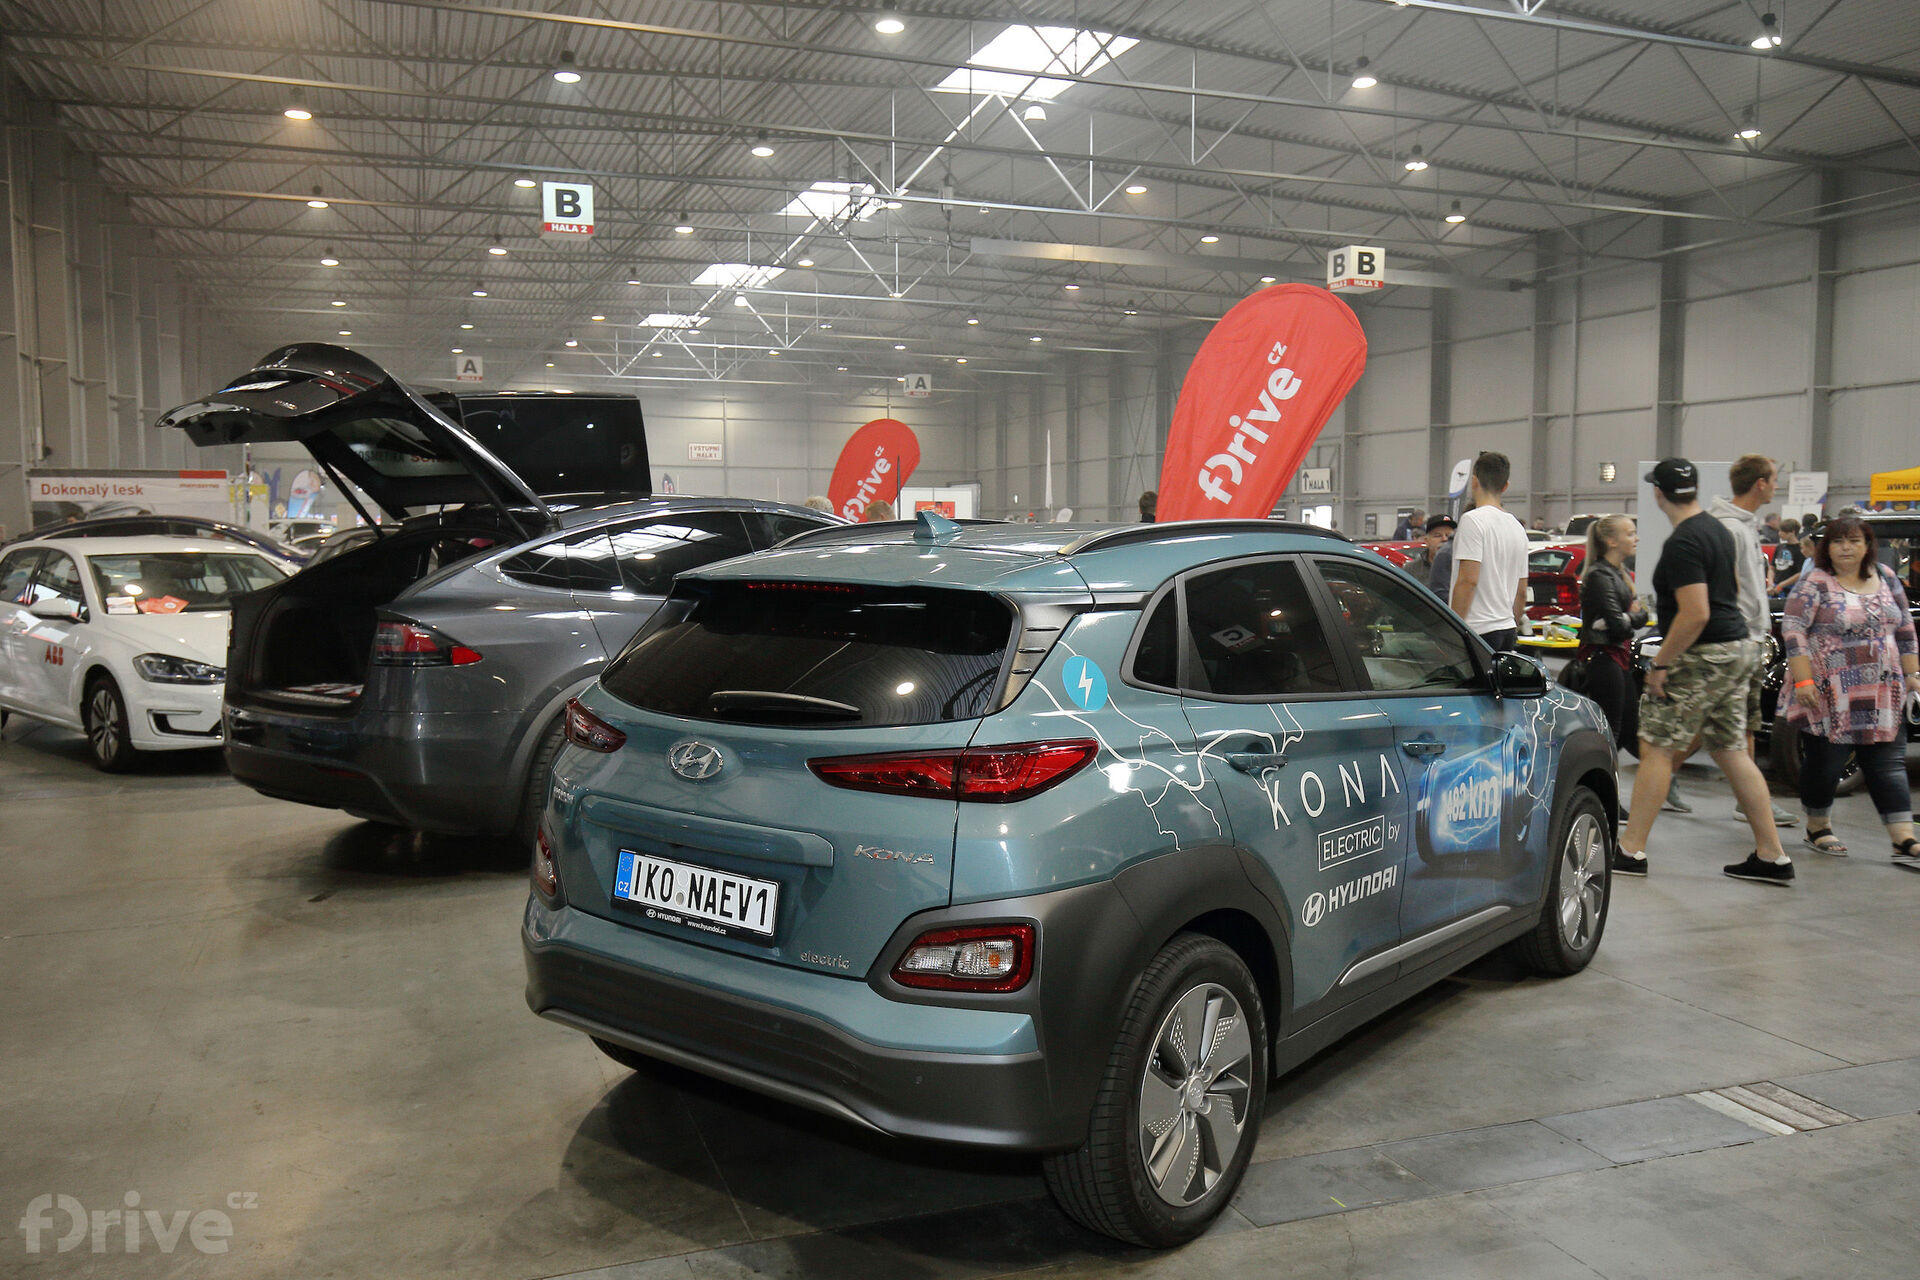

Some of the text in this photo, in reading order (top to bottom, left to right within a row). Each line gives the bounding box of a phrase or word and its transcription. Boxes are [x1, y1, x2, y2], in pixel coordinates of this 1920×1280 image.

[555, 188, 582, 218] B
[551, 223, 588, 233] HALA 2
[1333, 253, 1346, 278] B
[1358, 251, 1376, 275] B
[463, 359, 477, 374] A
[915, 376, 927, 390] A
[1198, 367, 1302, 505] fDrive
[40, 483, 144, 497] Dokonalý lesk
[1308, 479, 1325, 490] HALA
[45, 645, 64, 666] ABB
[1266, 753, 1400, 831] KONA
[1447, 775, 1499, 822] 482 km
[1323, 822, 1400, 862] ELECTRIC by
[854, 844, 935, 865] KONA
[618, 880, 629, 893] CZ
[1328, 865, 1398, 913] HYUNDAI
[657, 911, 682, 924] HYUNDAI
[801, 950, 850, 970] electric
